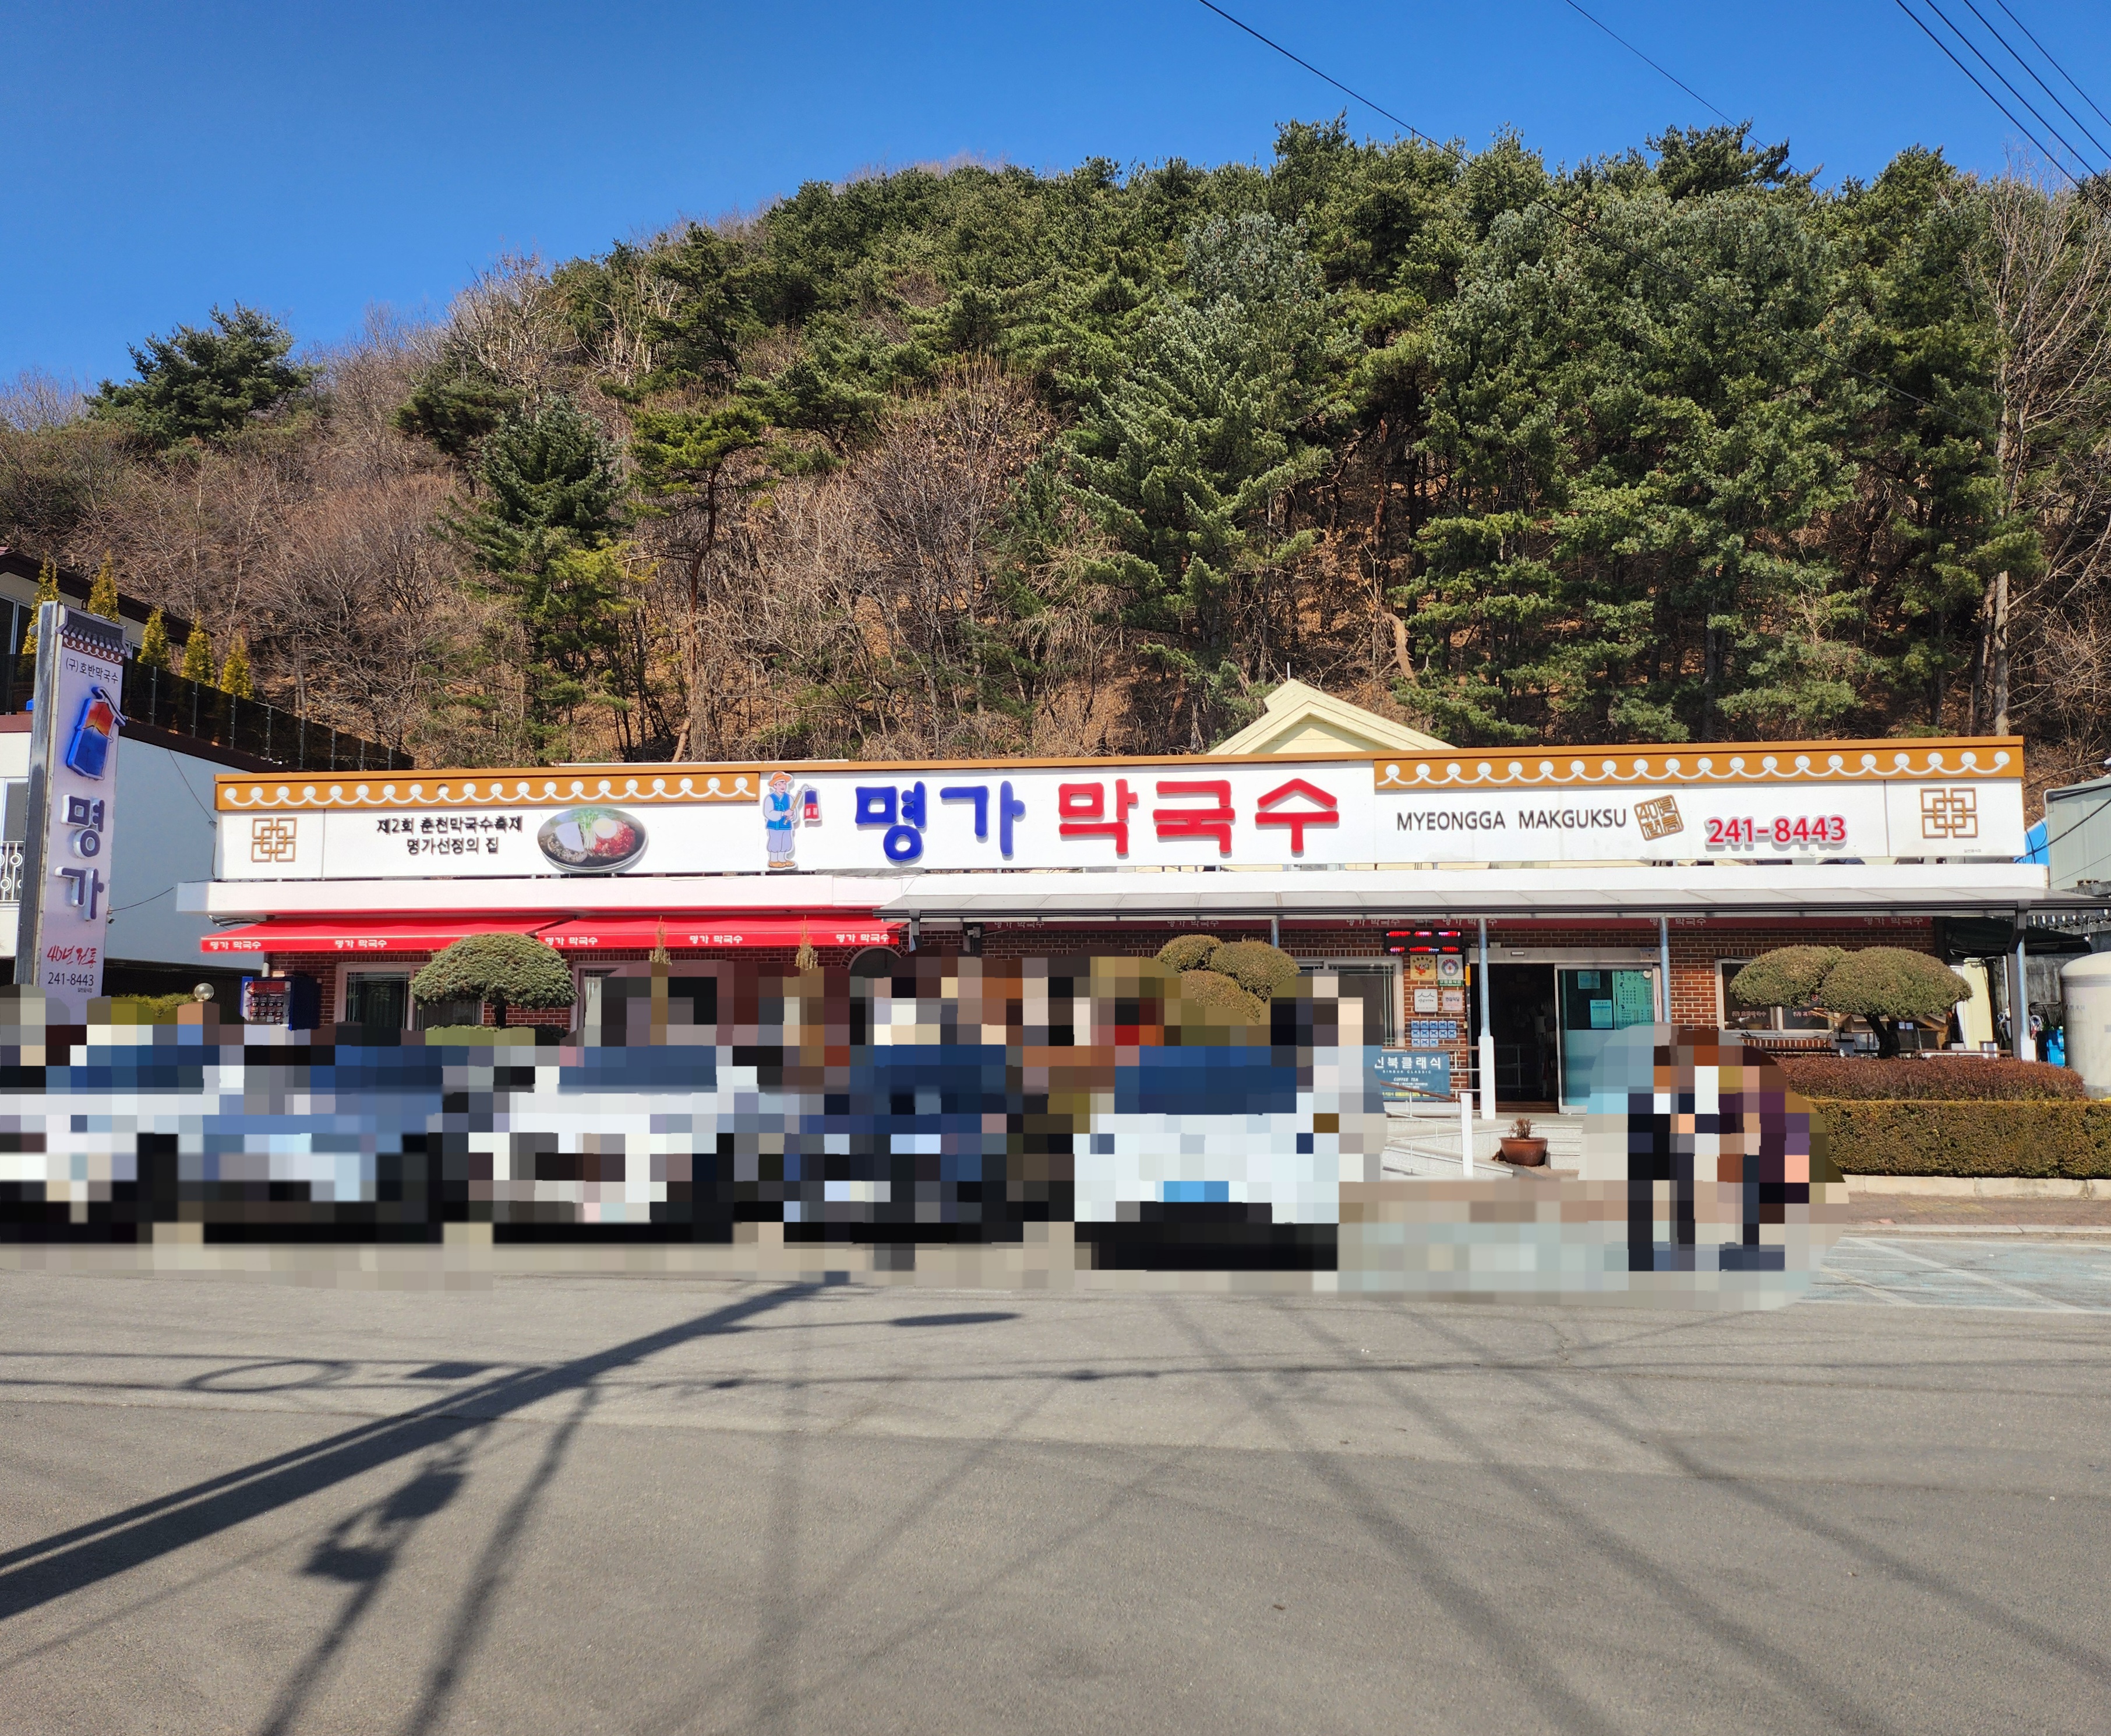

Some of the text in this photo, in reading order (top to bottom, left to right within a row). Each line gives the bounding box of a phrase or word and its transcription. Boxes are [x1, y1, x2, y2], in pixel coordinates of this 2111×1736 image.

[376, 815, 523, 835] 제2회 춘천막국수축제
[855, 779, 1340, 862] 명가 막국수
[1397, 809, 1627, 831] MYEONGGA MAKGUKSU
[1707, 816, 1846, 844] 241-8443
[407, 836, 499, 856] 명가선정의 집
[57, 794, 105, 920] 명가
[210, 941, 262, 950] 명가 막국수
[335, 939, 387, 948] 명가 막국수
[545, 936, 598, 946] 명가 막국수
[690, 935, 743, 944] 명가 막국수
[835, 933, 890, 943] 명가 막국수
[47, 945, 75, 965] 40년
[48, 972, 94, 987] 241-8443
